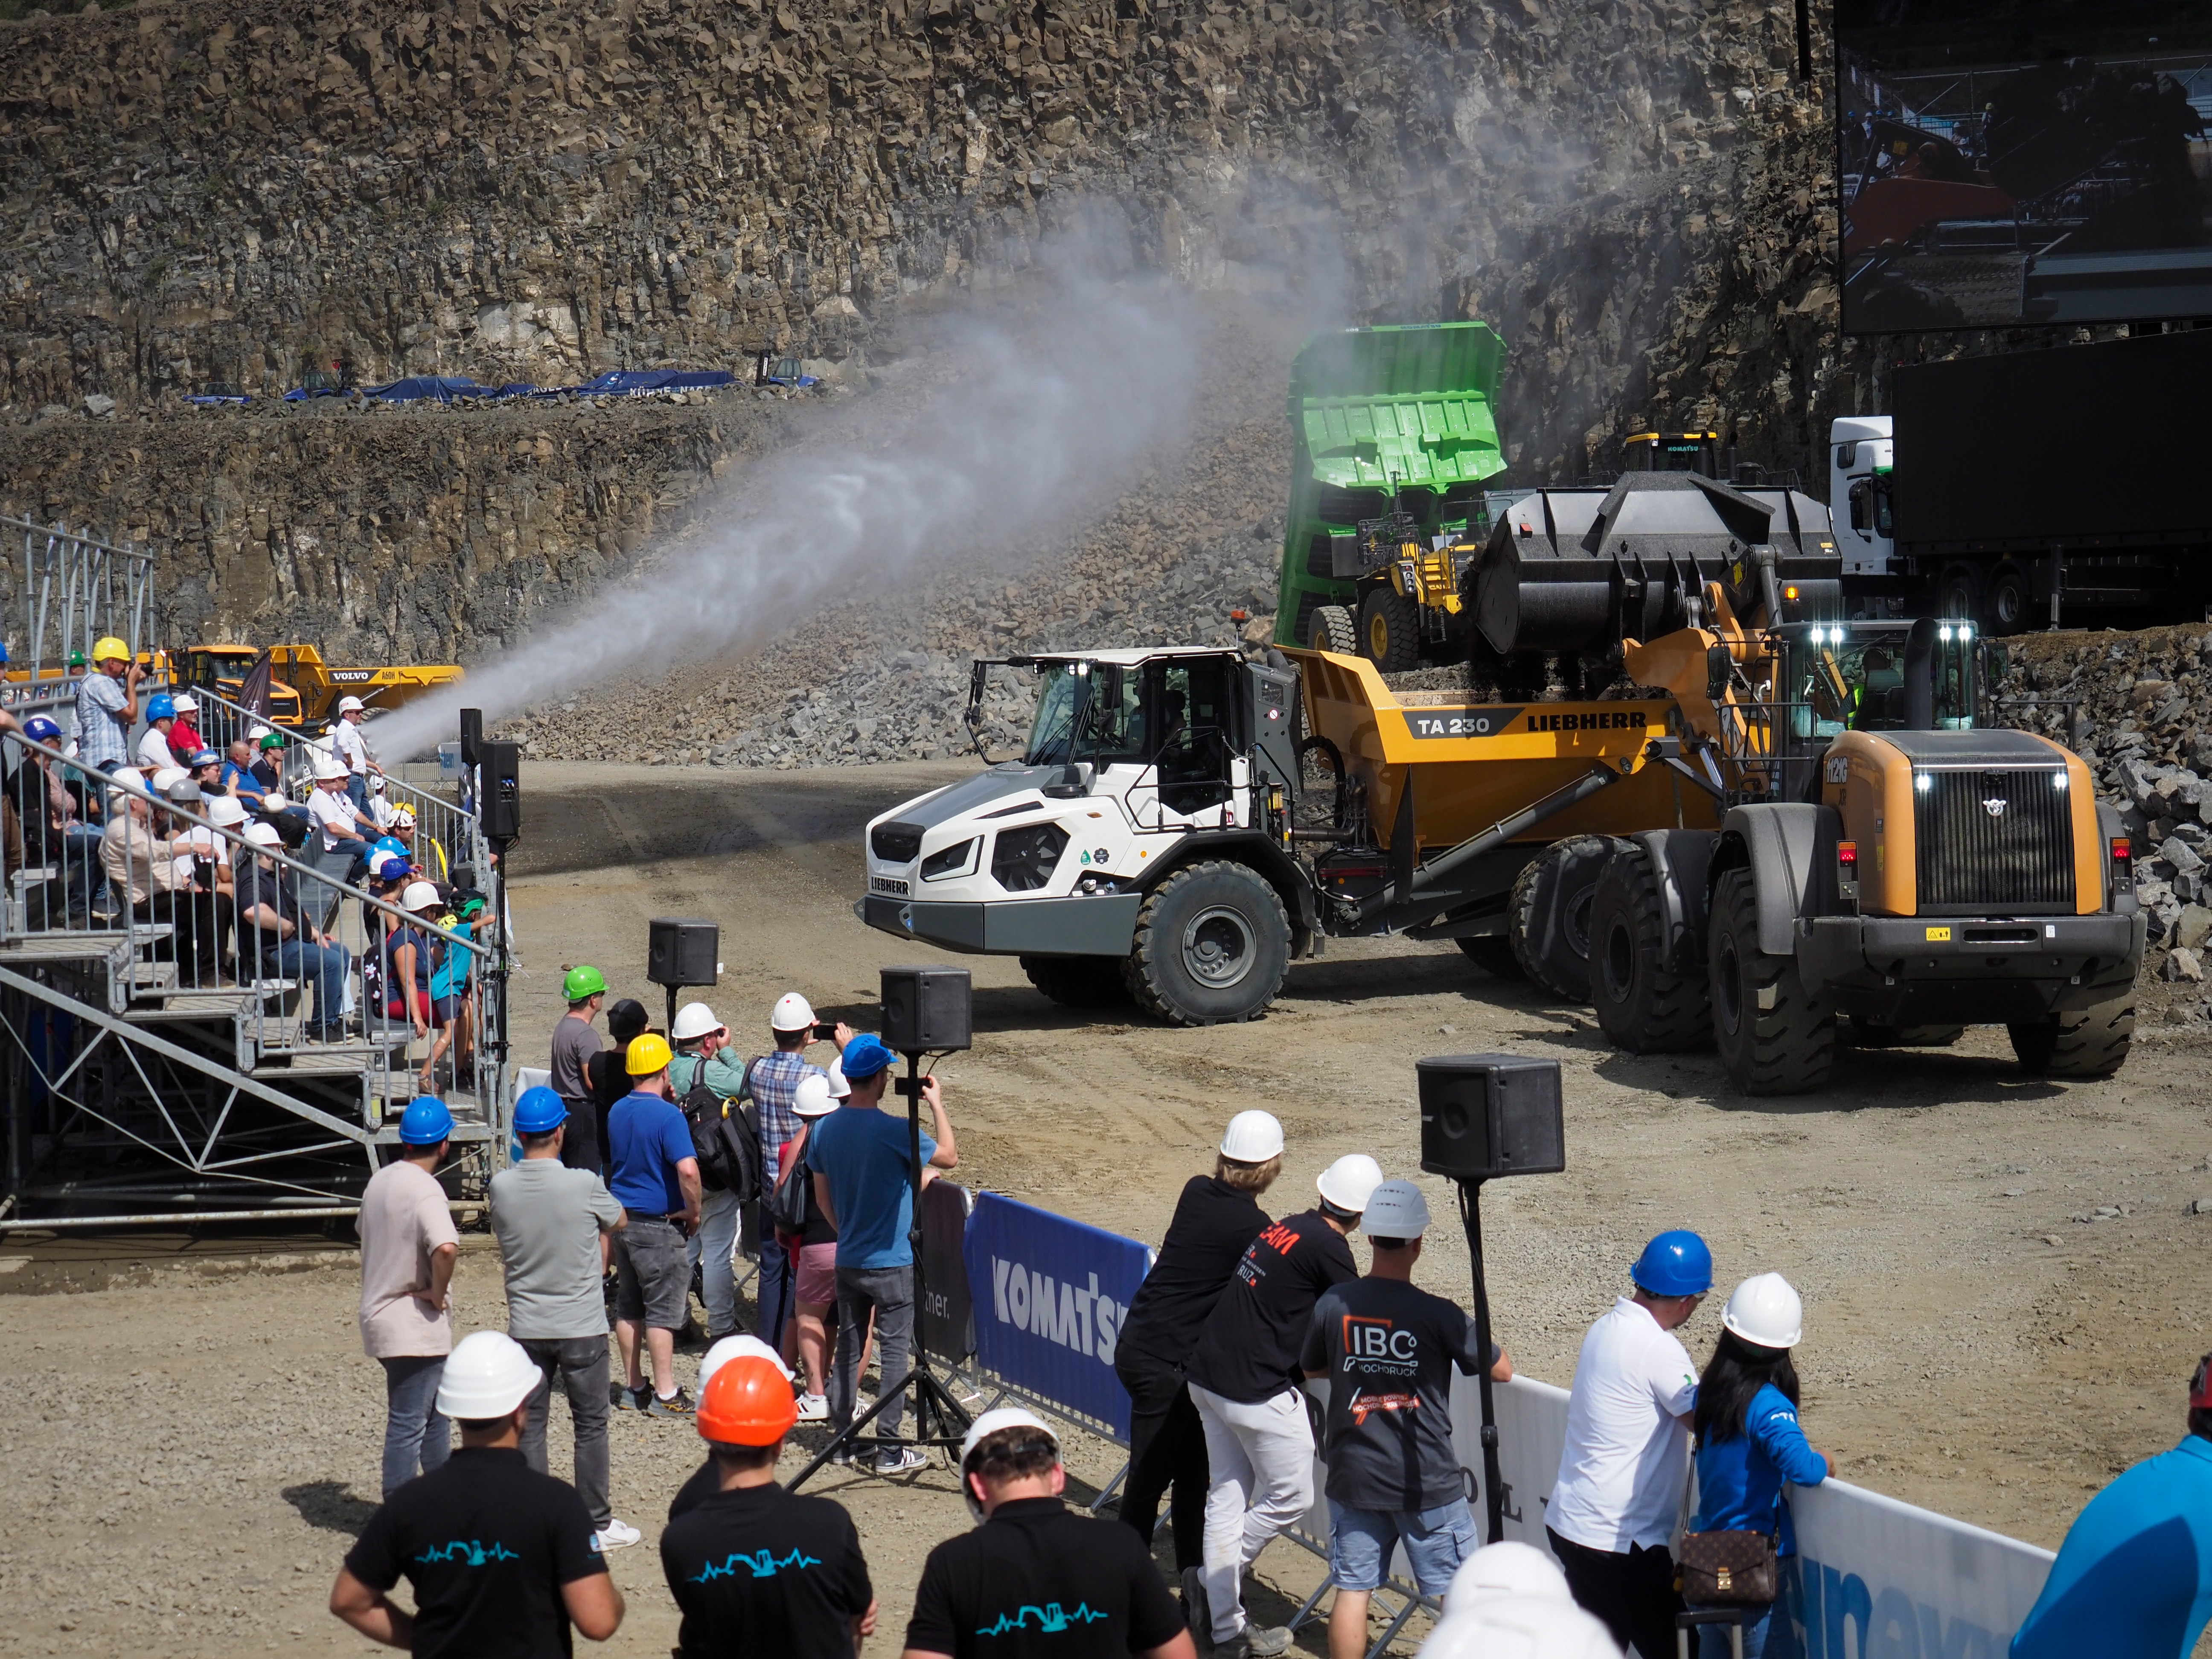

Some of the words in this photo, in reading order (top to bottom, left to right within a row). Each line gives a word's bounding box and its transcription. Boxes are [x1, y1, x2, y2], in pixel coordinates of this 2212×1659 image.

[1417, 719, 1445, 734] TA
[1449, 718, 1490, 733] 230
[1528, 712, 1646, 731] LIEBHERR
[1827, 756, 1848, 783] 1121G
[871, 876, 909, 895] LIEBHERR
[1353, 1326, 1415, 1359] IBC
[1359, 1364, 1417, 1377] HOCHDRUCK
